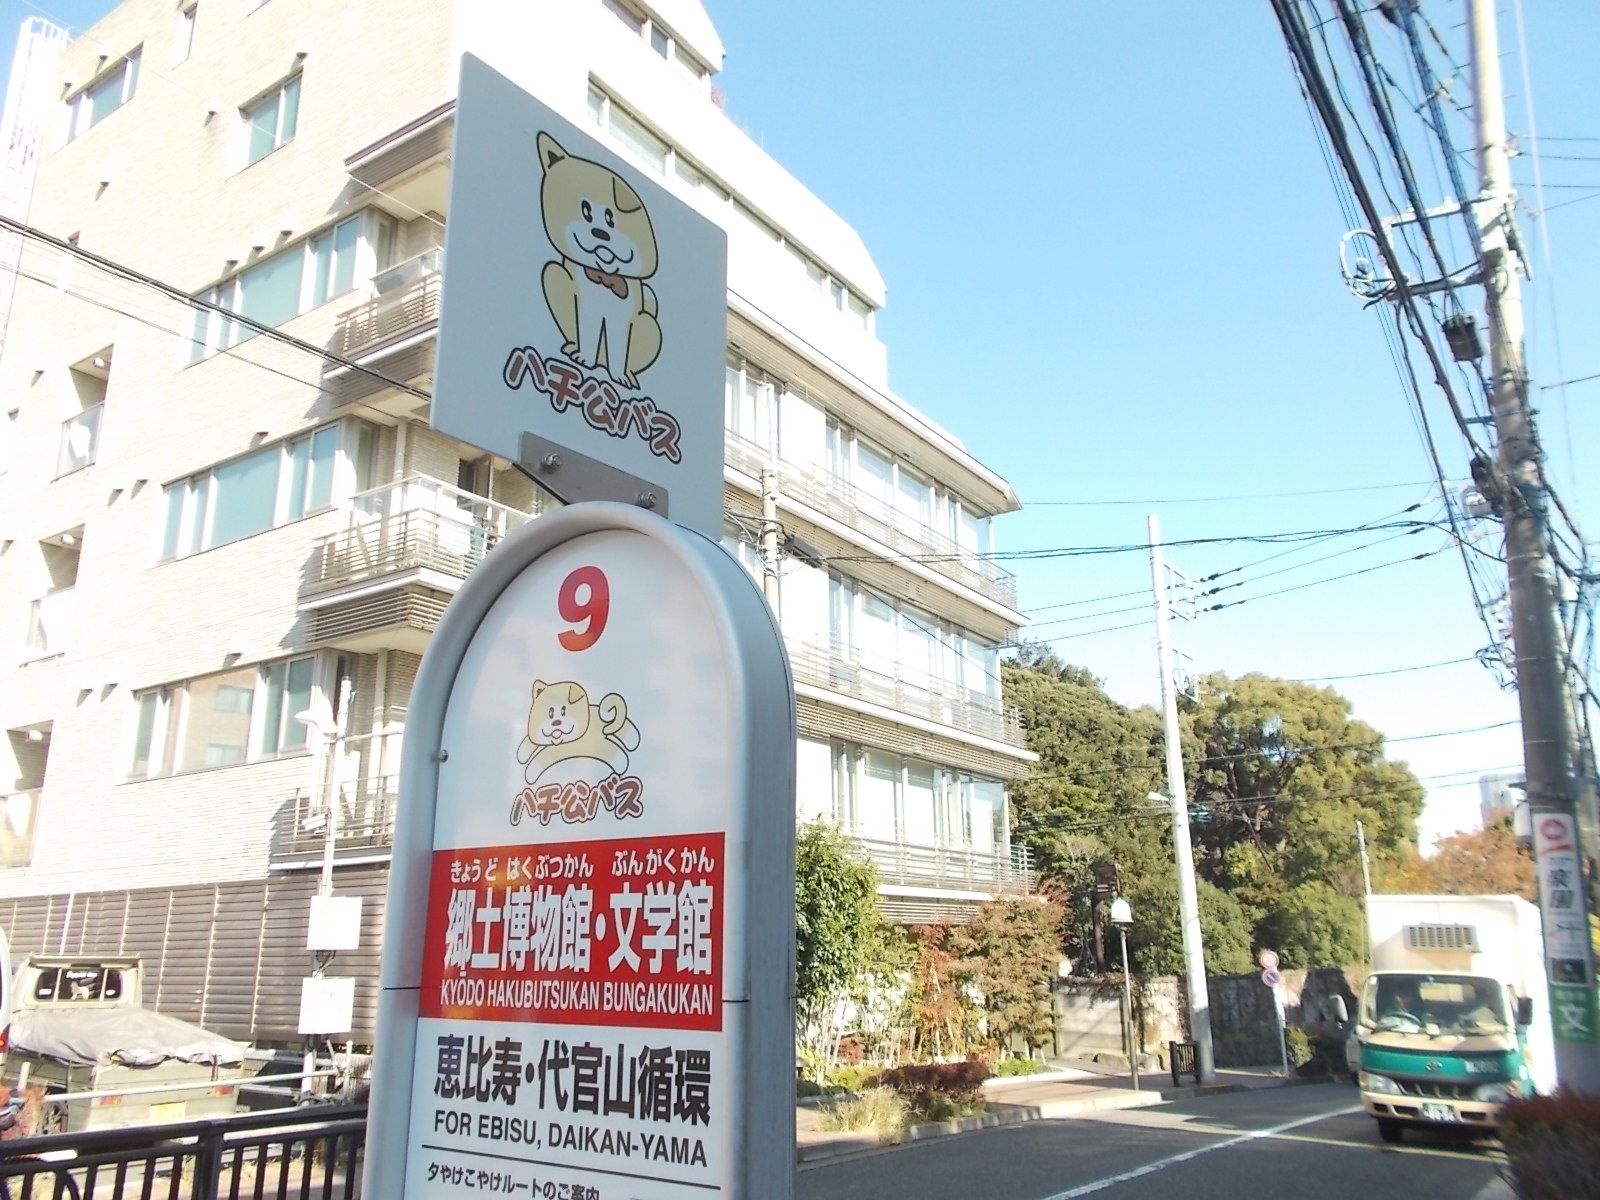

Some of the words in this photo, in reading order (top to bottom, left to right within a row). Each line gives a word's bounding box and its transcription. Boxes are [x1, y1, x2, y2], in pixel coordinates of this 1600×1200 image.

[503, 346, 681, 464] ハチ公バス
[557, 565, 610, 652] 9
[510, 774, 643, 827] ハチ公バス
[507, 853, 593, 881] はくぶつかん
[612, 846, 714, 876] ぶんがくかん
[444, 879, 713, 975] 郷土博物館・文学館
[487, 979, 599, 1011] HAKUBUTSUKAN
[603, 982, 713, 1015] BUNGAKUKAN
[434, 1033, 711, 1127] 恵比寿・代官山循環
[434, 1109, 472, 1136] FOR
[478, 1115, 543, 1149] EBISU,
[548, 1122, 708, 1167] DAIKAN-YAMA
